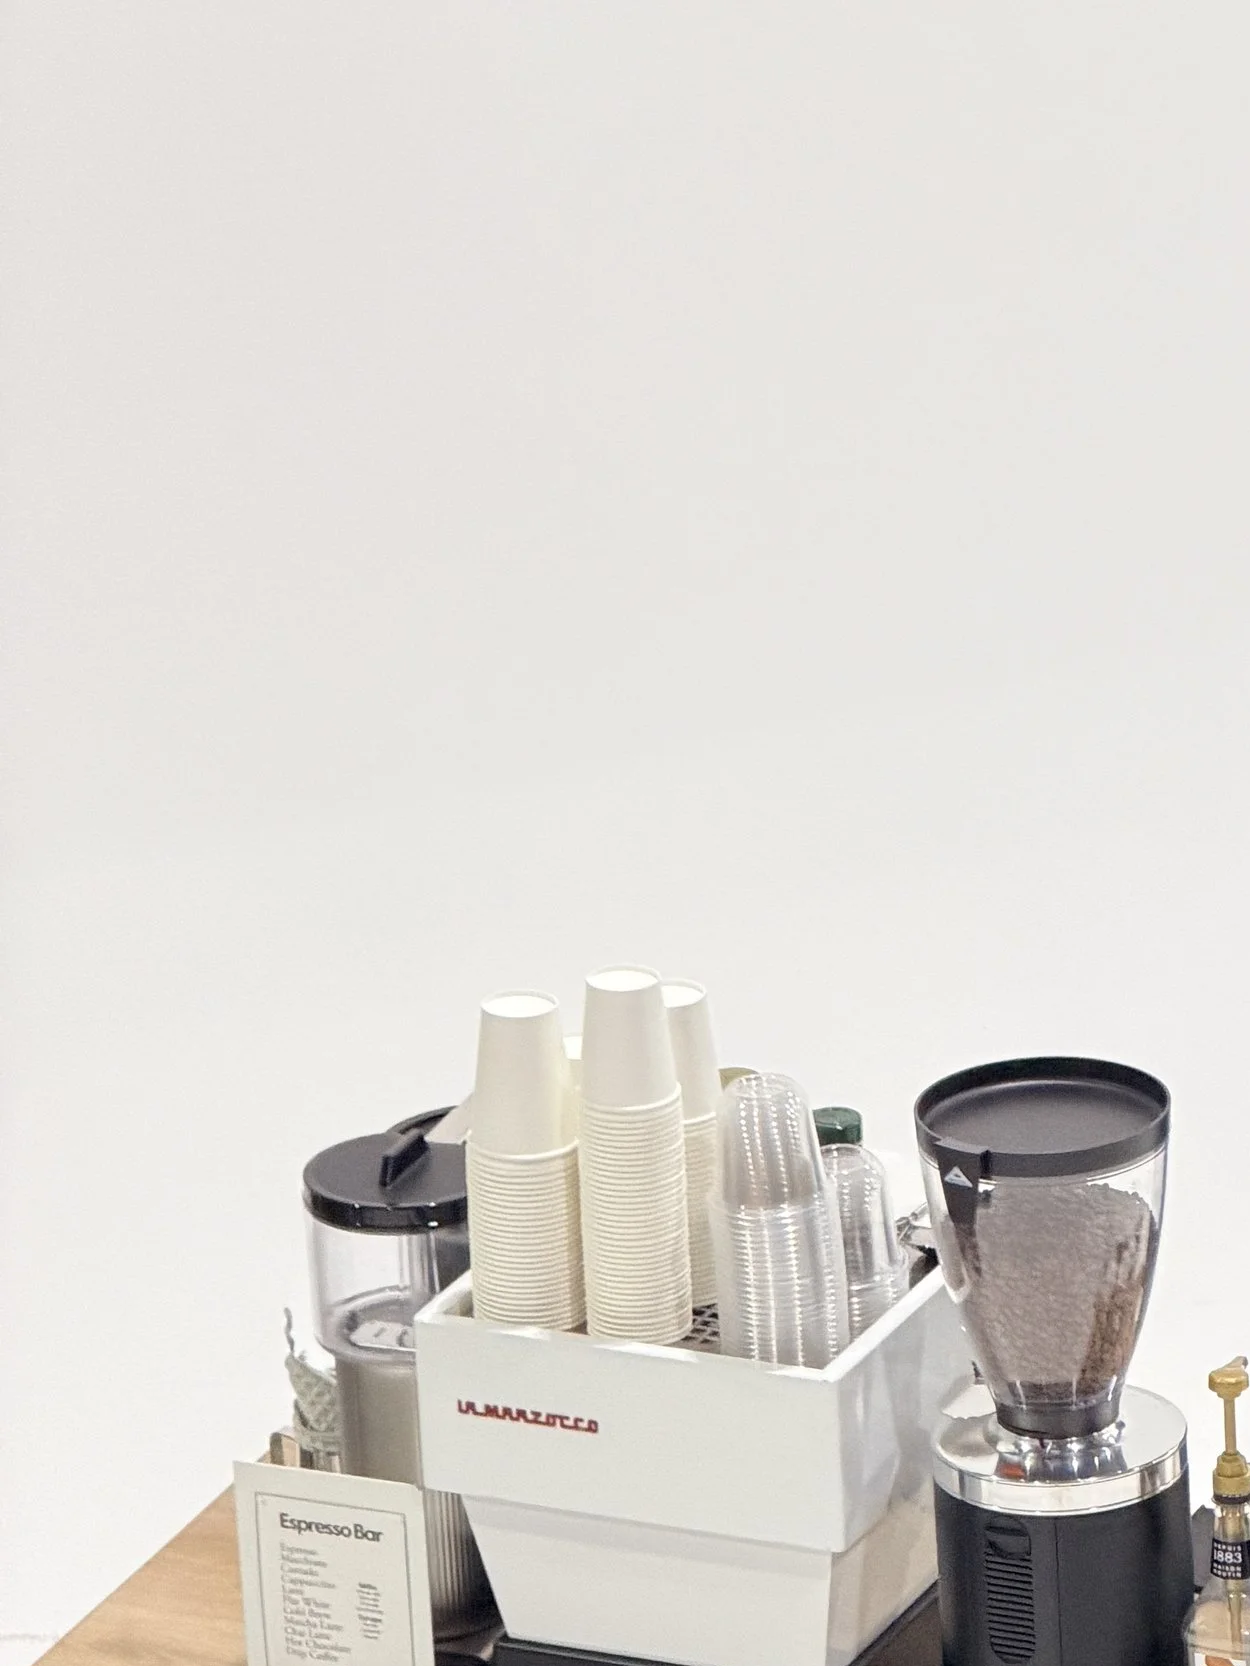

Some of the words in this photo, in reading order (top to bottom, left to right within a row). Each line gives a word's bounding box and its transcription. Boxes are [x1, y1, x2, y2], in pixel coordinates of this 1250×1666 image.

[457, 1399, 482, 1416] LA
[483, 1403, 599, 1434] MARZOCCO
[279, 1512, 351, 1538] Espresso
[353, 1523, 383, 1542] Bar
[1213, 1548, 1242, 1564] 1883
